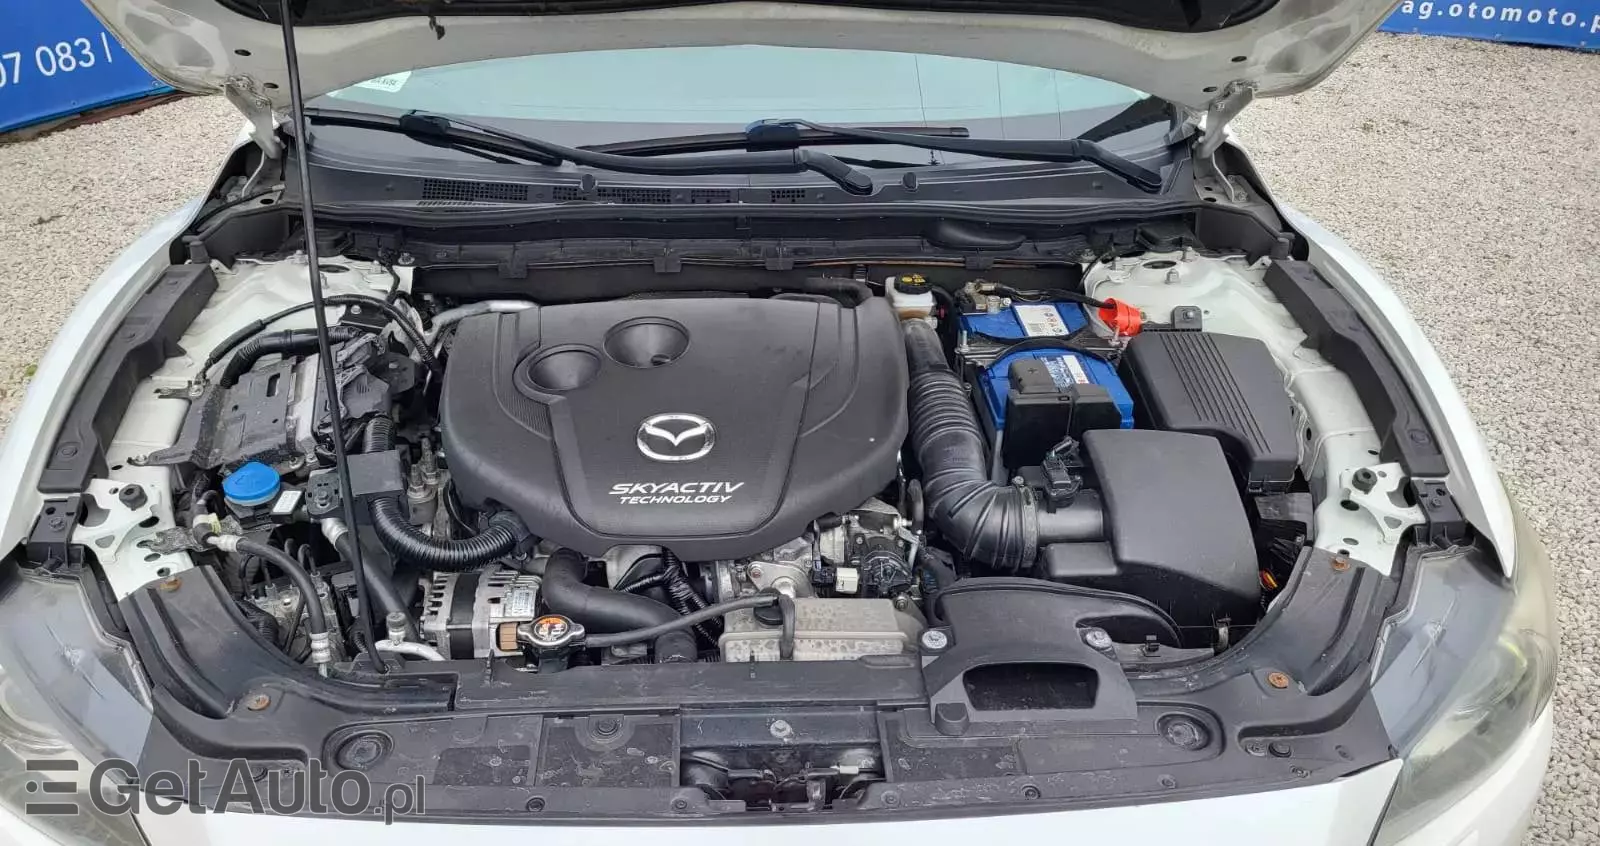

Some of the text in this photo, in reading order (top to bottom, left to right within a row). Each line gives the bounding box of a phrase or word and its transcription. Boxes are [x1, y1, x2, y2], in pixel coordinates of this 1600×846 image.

[35, 37, 95, 76] 083
[609, 482, 744, 495] SKYACTIV
[620, 495, 732, 505] TECHNOLOGY
